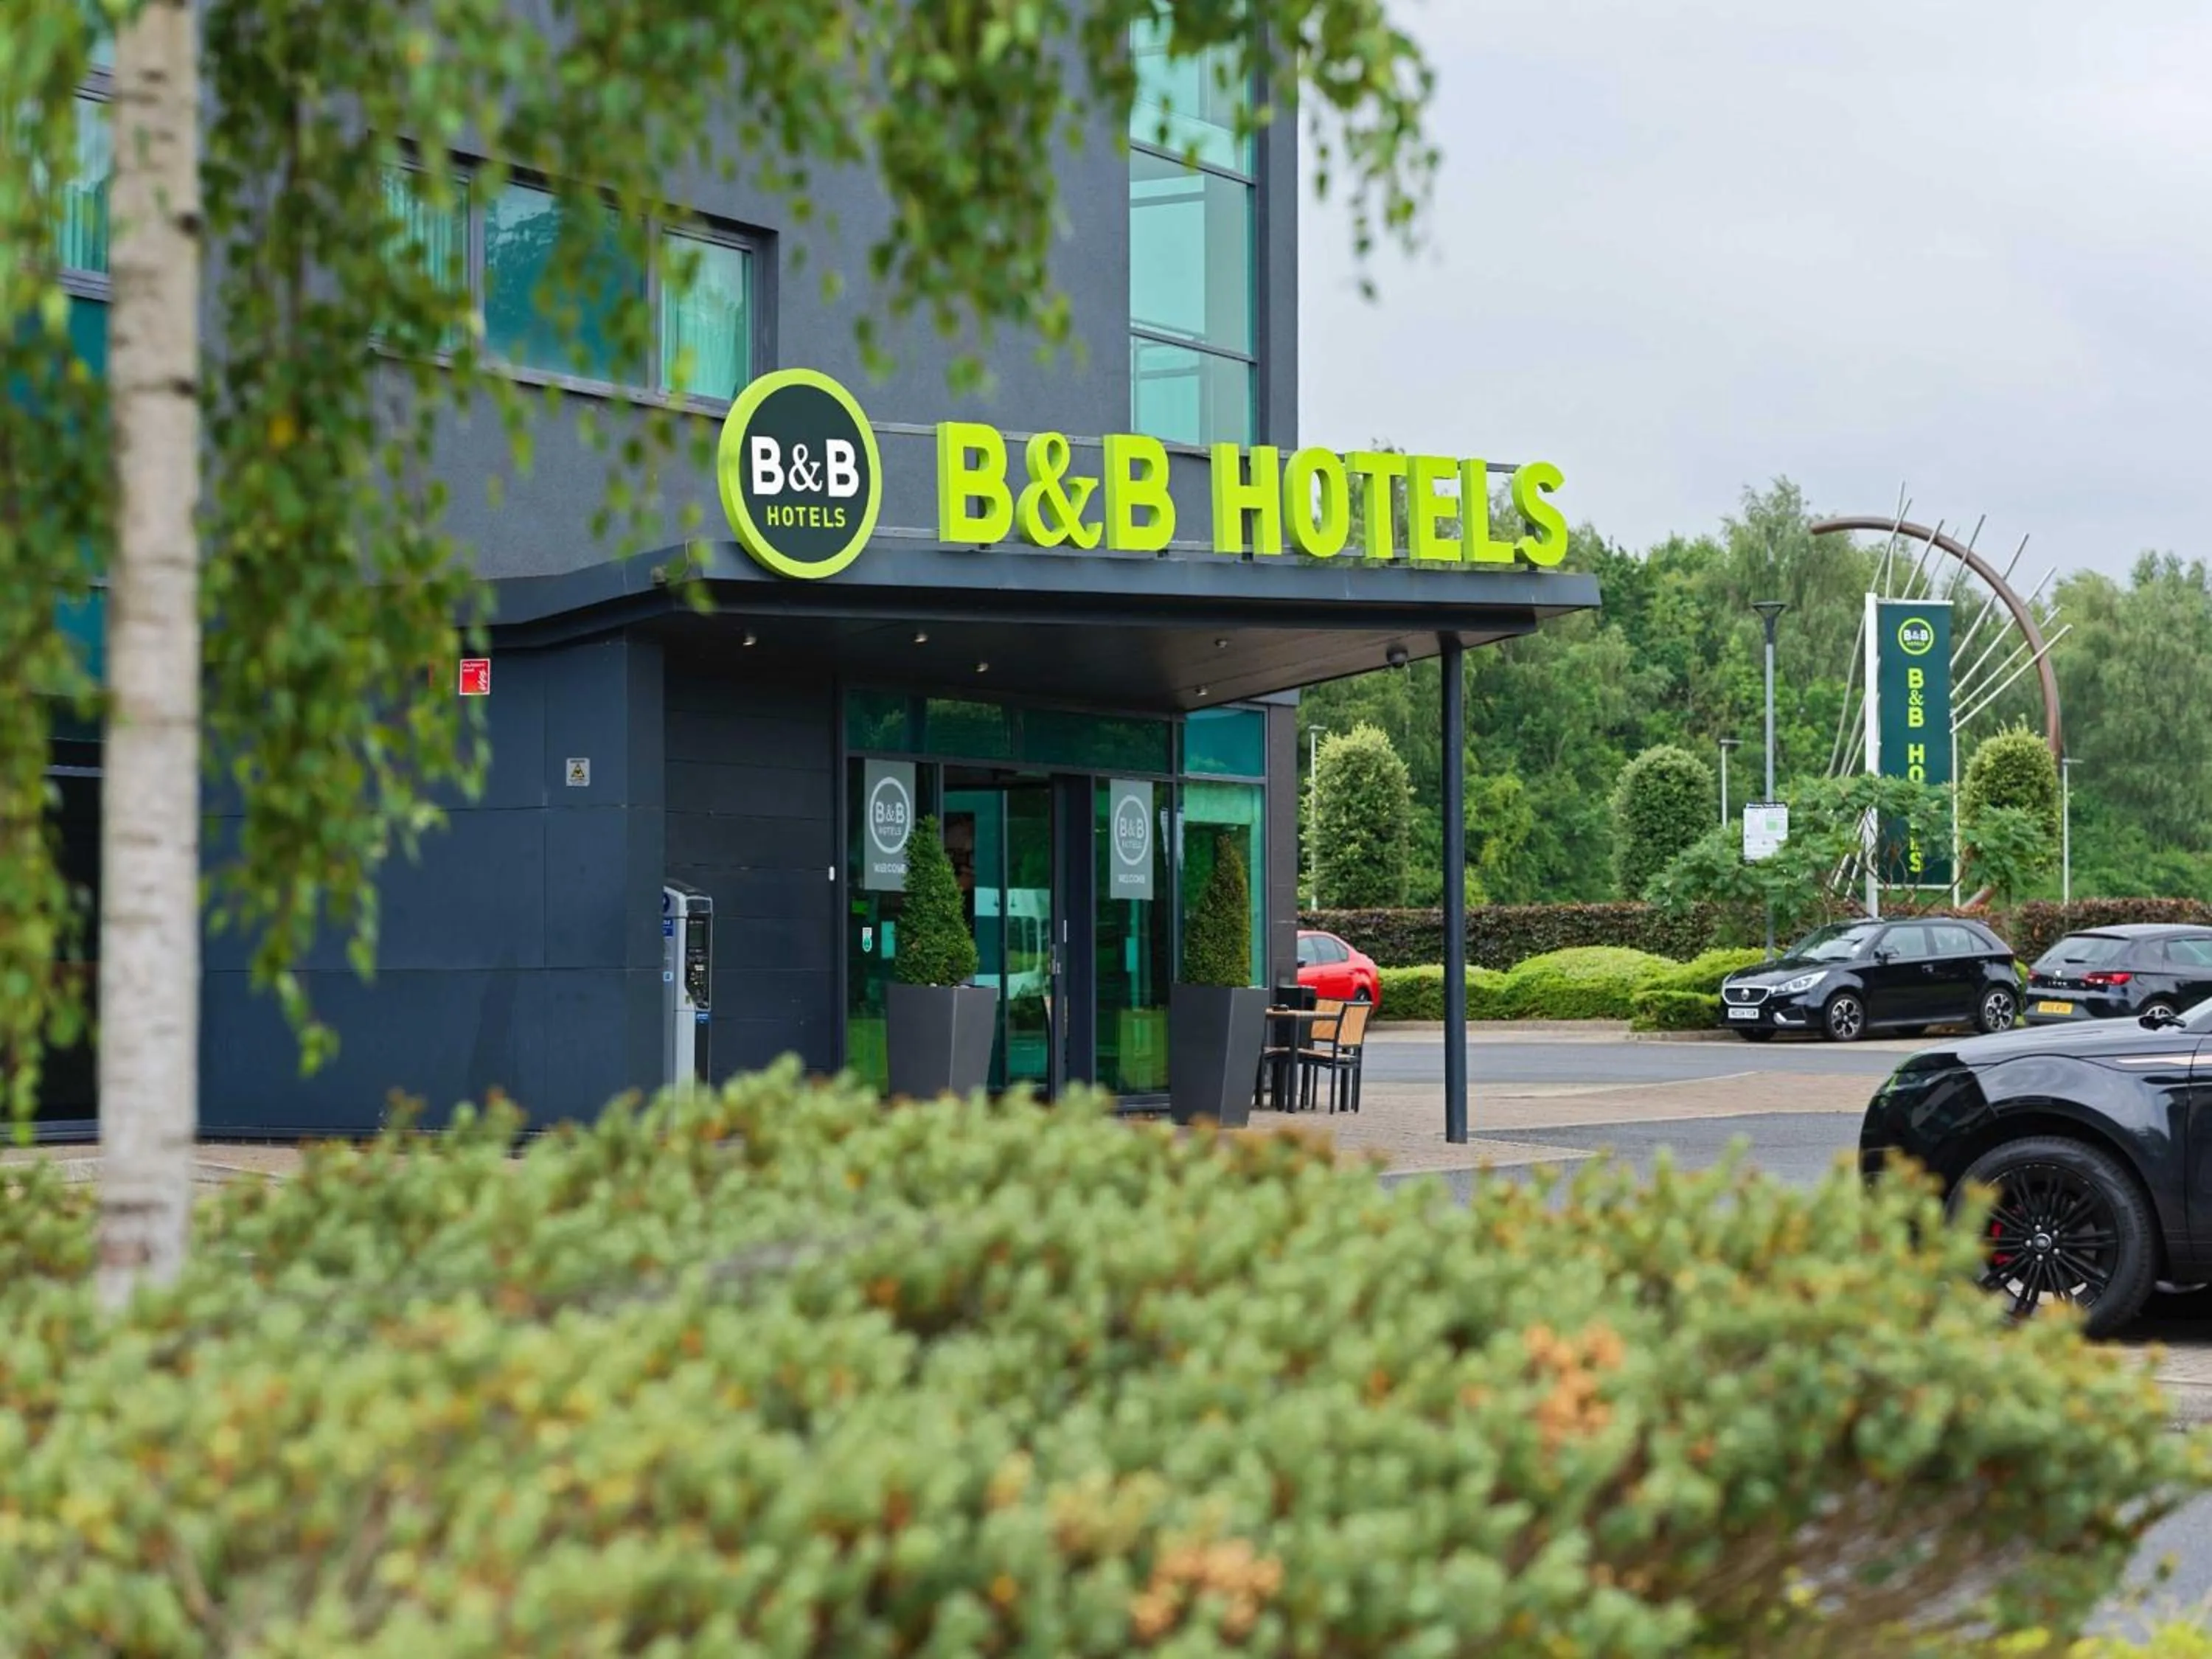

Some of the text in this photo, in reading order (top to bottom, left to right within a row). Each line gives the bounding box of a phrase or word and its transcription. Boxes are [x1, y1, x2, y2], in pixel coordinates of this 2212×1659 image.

[751, 435, 860, 498] B&B
[937, 421, 1568, 567] B&B HOTELS
[767, 505, 846, 528] HOTELS
[1903, 629, 1928, 641] B&B
[1907, 667, 1924, 728] B&B
[875, 801, 905, 824] B&B
[1119, 817, 1144, 839] B&B
